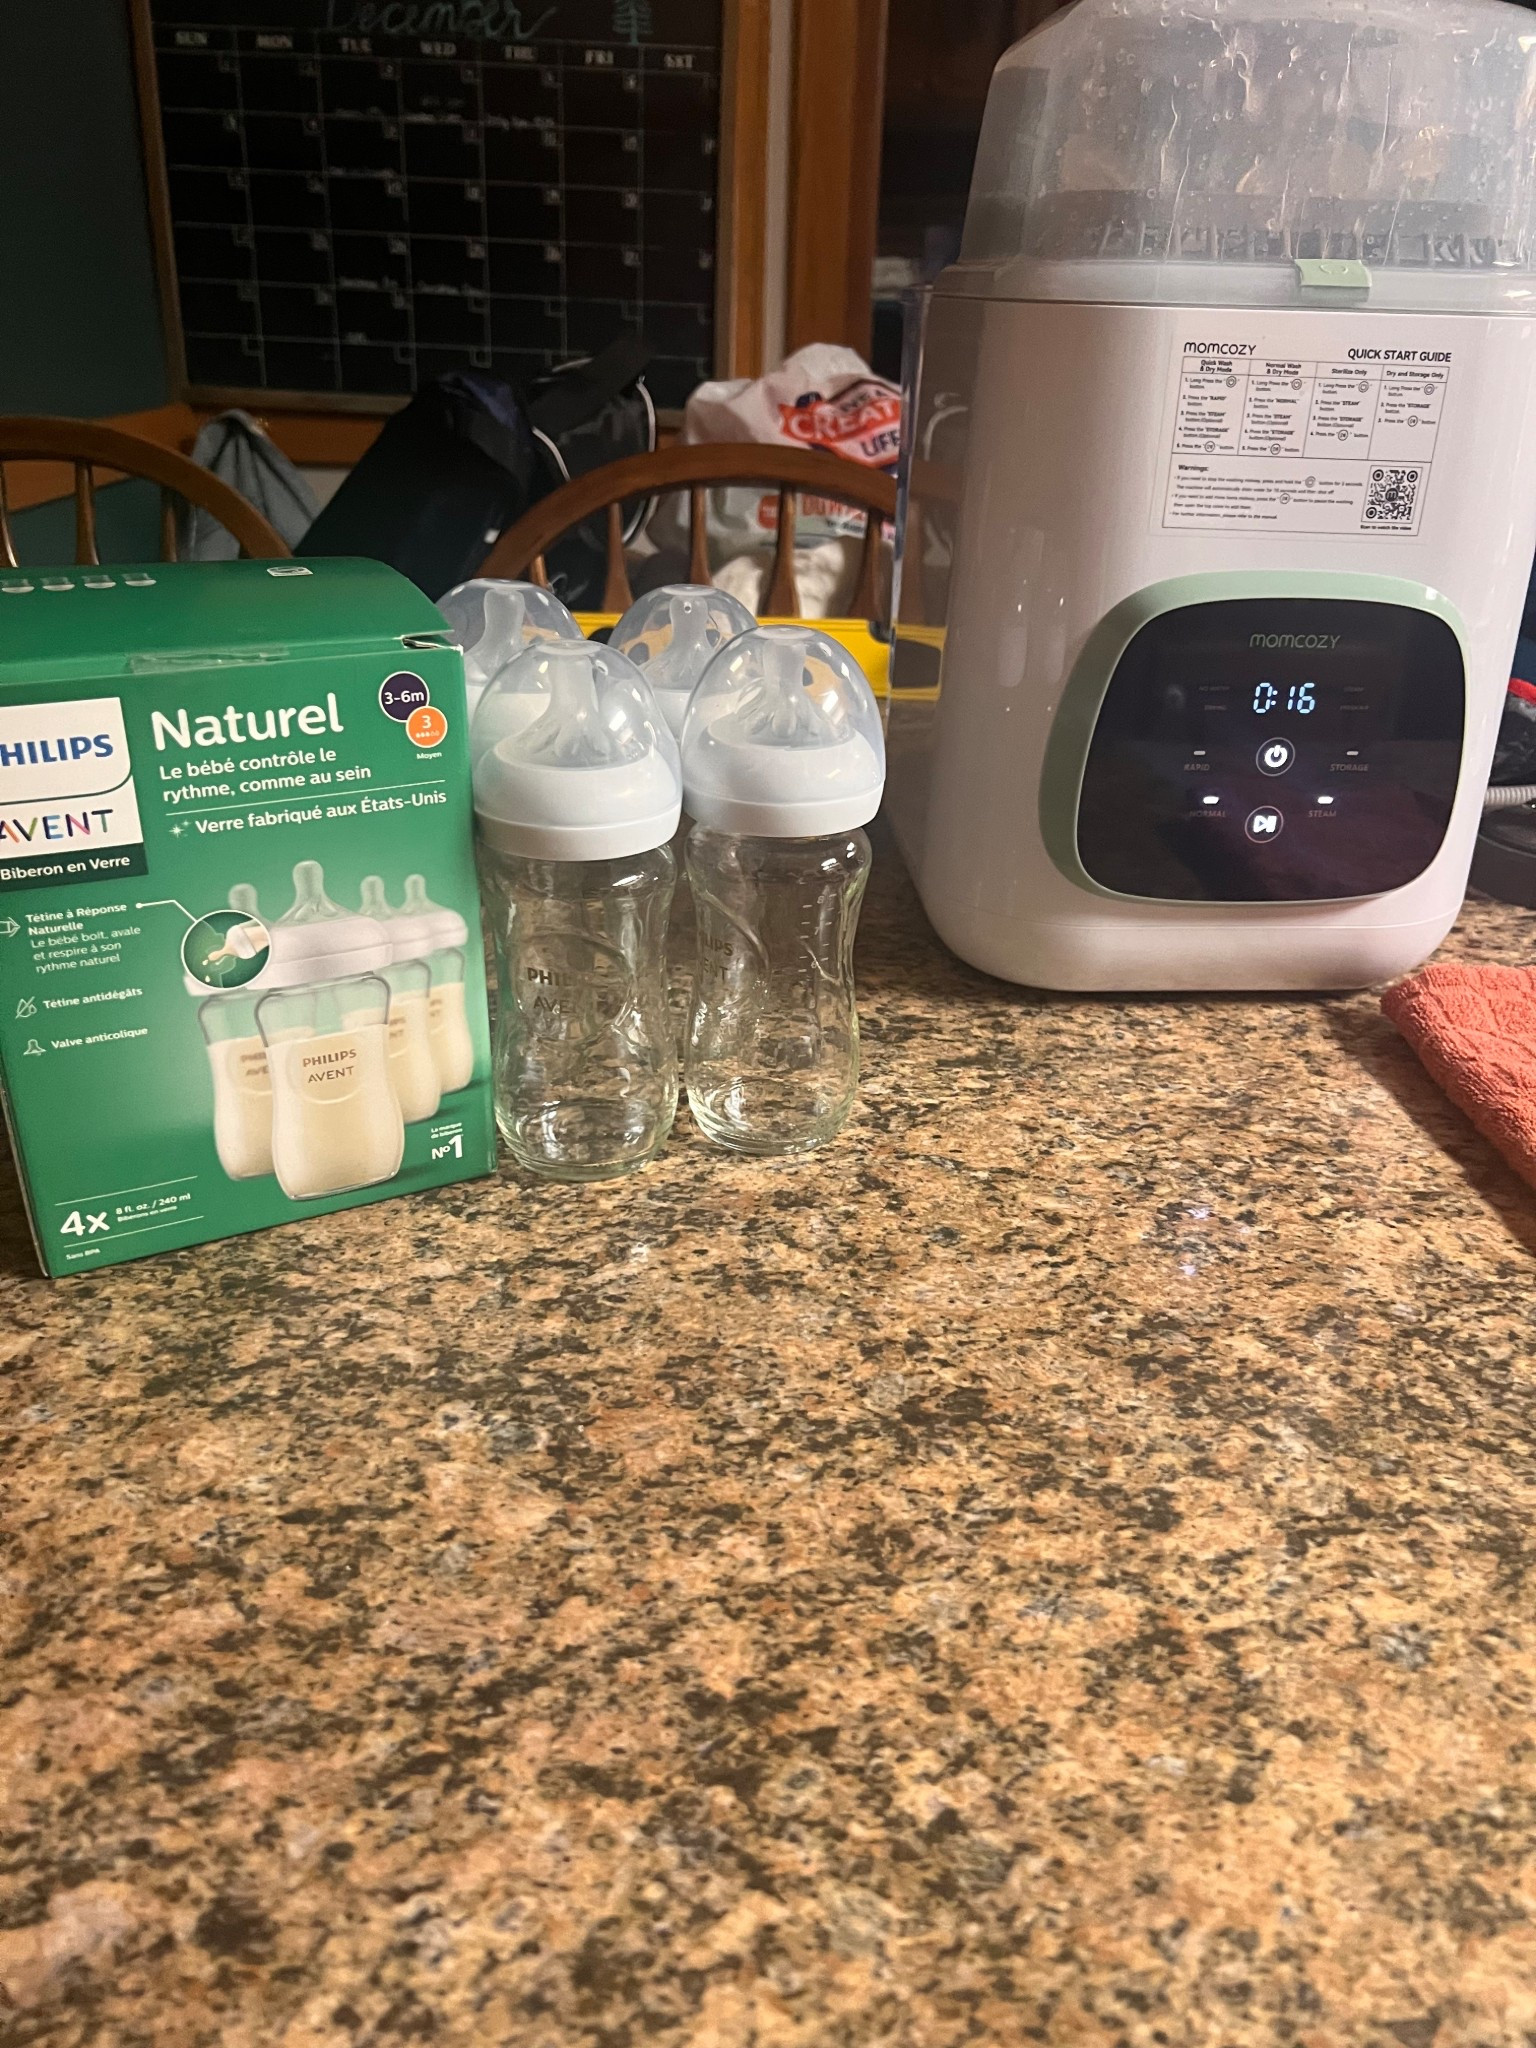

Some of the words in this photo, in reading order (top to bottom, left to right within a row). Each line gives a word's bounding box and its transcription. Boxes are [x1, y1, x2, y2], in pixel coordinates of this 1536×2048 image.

[1348, 348, 1382, 360] QUICK
[1384, 350, 1418, 360] START
[1419, 351, 1452, 362] GUIDE
[1206, 366, 1215, 374] Dry
[1386, 370, 1396, 378] Dry
[384, 690, 424, 705] 3-6m
[1252, 682, 1316, 714] 0:16
[150, 692, 344, 751] Naturel
[422, 715, 432, 729] 3
[0, 734, 114, 767] HILIPS
[416, 751, 442, 760] Moyen
[160, 764, 182, 780] Le
[187, 760, 236, 778] bébé
[240, 750, 316, 771] contrôle
[320, 748, 336, 762] le
[1184, 763, 1211, 772] RAPID
[1329, 764, 1370, 772] STORAGE
[163, 783, 236, 804] rythme,
[240, 776, 306, 793] comme
[310, 772, 332, 785] au
[335, 765, 372, 782] sein
[195, 816, 244, 834] Verre
[248, 804, 323, 828] fabriqué
[326, 804, 358, 818] aux
[360, 790, 447, 814] États-Unis
[1189, 810, 1227, 818] NORMAL
[1308, 810, 1337, 818] STEAM
[0, 864, 64, 880] Biberon
[66, 862, 87, 873] en
[90, 856, 130, 870] Verre
[25, 912, 64, 923] Tétine
[66, 908, 74, 918] à
[76, 904, 128, 918] Réponse
[28, 922, 84, 936] Naturelle
[30, 939, 46, 948] Le
[48, 934, 79, 946] bébé
[111, 926, 141, 938] avale
[33, 952, 46, 961] et
[48, 946, 88, 958] respire
[90, 944, 98, 953] à
[100, 942, 122, 951] son
[36, 960, 78, 974] rythme
[80, 954, 120, 966] naturel
[42, 997, 80, 1009] Tétine
[82, 987, 144, 1004] antidégâts
[51, 1036, 83, 1049] Valve
[84, 1027, 148, 1044] anticolique
[302, 1048, 357, 1068] PHILIPS
[307, 1066, 354, 1084] AVENT
[116, 1207, 122, 1215] 8
[124, 1204, 134, 1214] fl.
[152, 1200, 157, 1209] /
[159, 1196, 178, 1206] 240
[178, 1192, 192, 1202] ml
[60, 1210, 111, 1236] 4x
